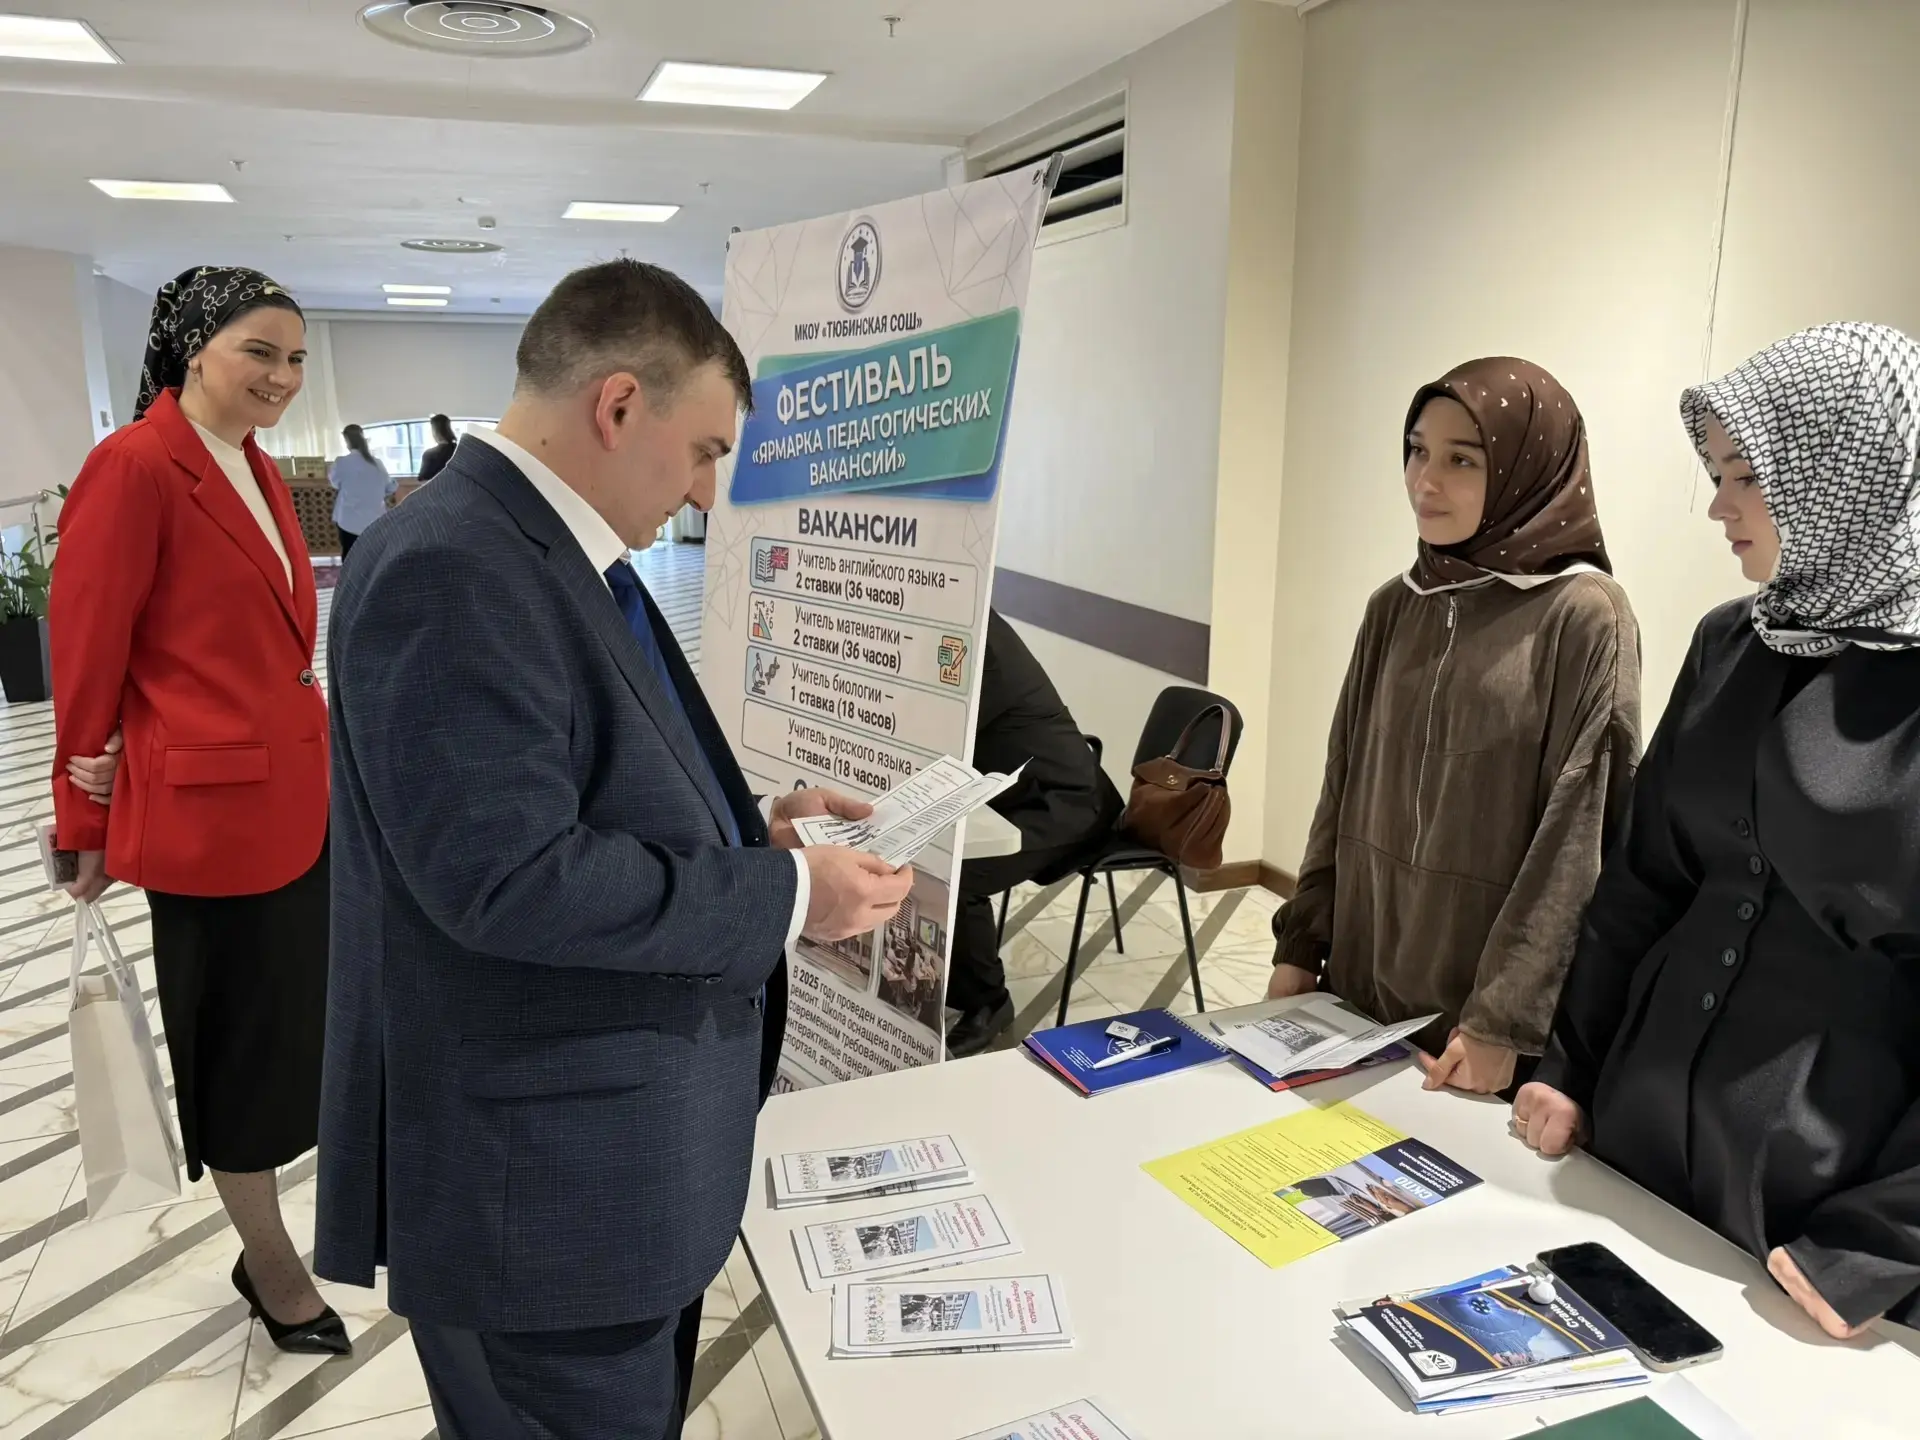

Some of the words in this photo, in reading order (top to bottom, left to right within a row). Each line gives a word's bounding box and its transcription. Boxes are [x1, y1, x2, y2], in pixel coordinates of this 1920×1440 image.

[794, 323, 819, 341] МКОУ
[822, 316, 887, 338] «ТЮБИНСКАЯ
[890, 312, 922, 331] СОШ»
[776, 344, 951, 424] ФЕСТИВАЛЬ
[752, 429, 823, 465] «ЯРМАРКА
[827, 388, 992, 450] ПЕДАГОГИЧЕСКИХ
[809, 442, 906, 486] ВАКАНСИЙ»
[799, 508, 917, 547] ВАКАНСИИ
[797, 549, 837, 572] Учитель
[838, 556, 905, 583] английского
[908, 568, 945, 588] языка
[796, 573, 802, 589] 2
[804, 576, 842, 597] ставки
[844, 580, 863, 601] (36
[865, 584, 905, 611] часов)
[795, 605, 834, 630] Учитель
[836, 617, 900, 645] математики
[793, 629, 800, 646] 2
[802, 633, 839, 655] ставки
[842, 638, 860, 661] (36
[862, 646, 901, 673] часов)
[791, 662, 831, 688] Учитель
[833, 673, 882, 703] биологии
[791, 685, 796, 701] 1
[799, 690, 835, 713] ставка
[837, 697, 855, 721] (18
[857, 705, 896, 735] часов)
[787, 741, 792, 757] 1
[795, 747, 831, 771] ставка
[833, 754, 851, 778] (18
[853, 763, 892, 792] часов)
[788, 718, 827, 748] Учитель
[829, 731, 875, 763] русского
[877, 750, 912, 777] языка
[788, 999, 840, 1039] современным
[790, 984, 819, 1010] ремонт.
[822, 1001, 847, 1026] Школа
[848, 1019, 889, 1050] оснащена
[891, 1045, 902, 1059] по
[793, 965, 799, 979] В
[799, 969, 819, 990] 2025
[819, 982, 835, 1003] году
[836, 995, 875, 1025] проведен
[877, 1016, 934, 1061] капитальный
[786, 1016, 841, 1060] интерактивные
[1392, 1175, 1433, 1199] СКПО
[1548, 1299, 1579, 1332] Стань
